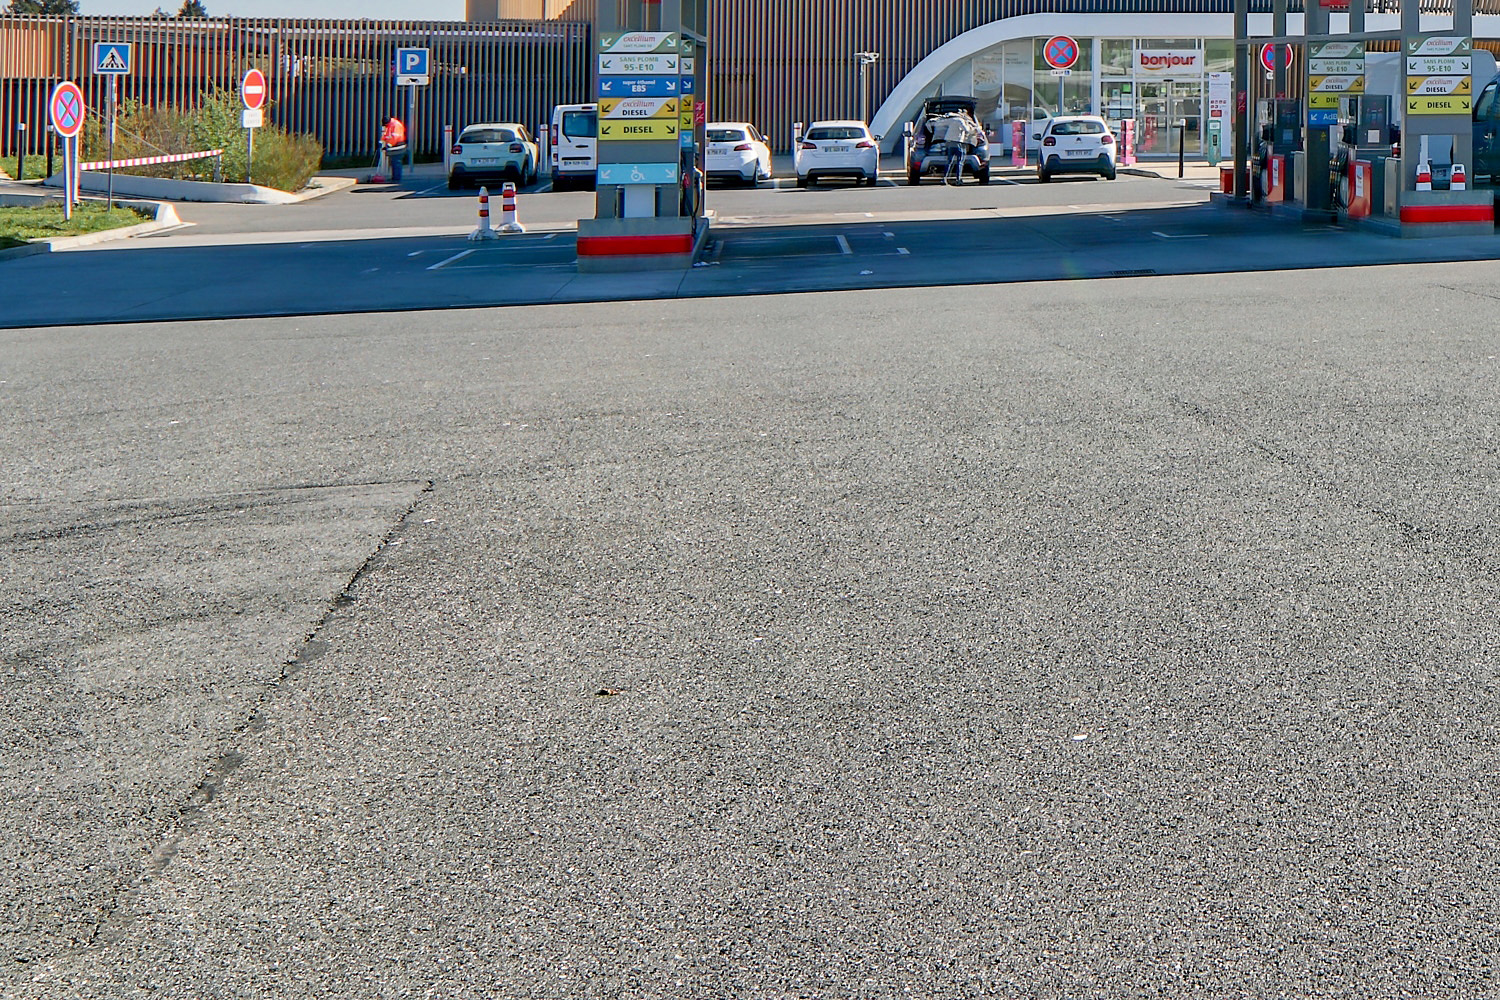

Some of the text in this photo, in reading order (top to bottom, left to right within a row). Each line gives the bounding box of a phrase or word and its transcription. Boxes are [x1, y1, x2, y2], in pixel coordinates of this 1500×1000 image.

[406, 53, 420, 71] P
[1140, 52, 1196, 69] bonjour
[624, 63, 654, 71] 95-E10
[623, 126, 654, 134] DIESEL
